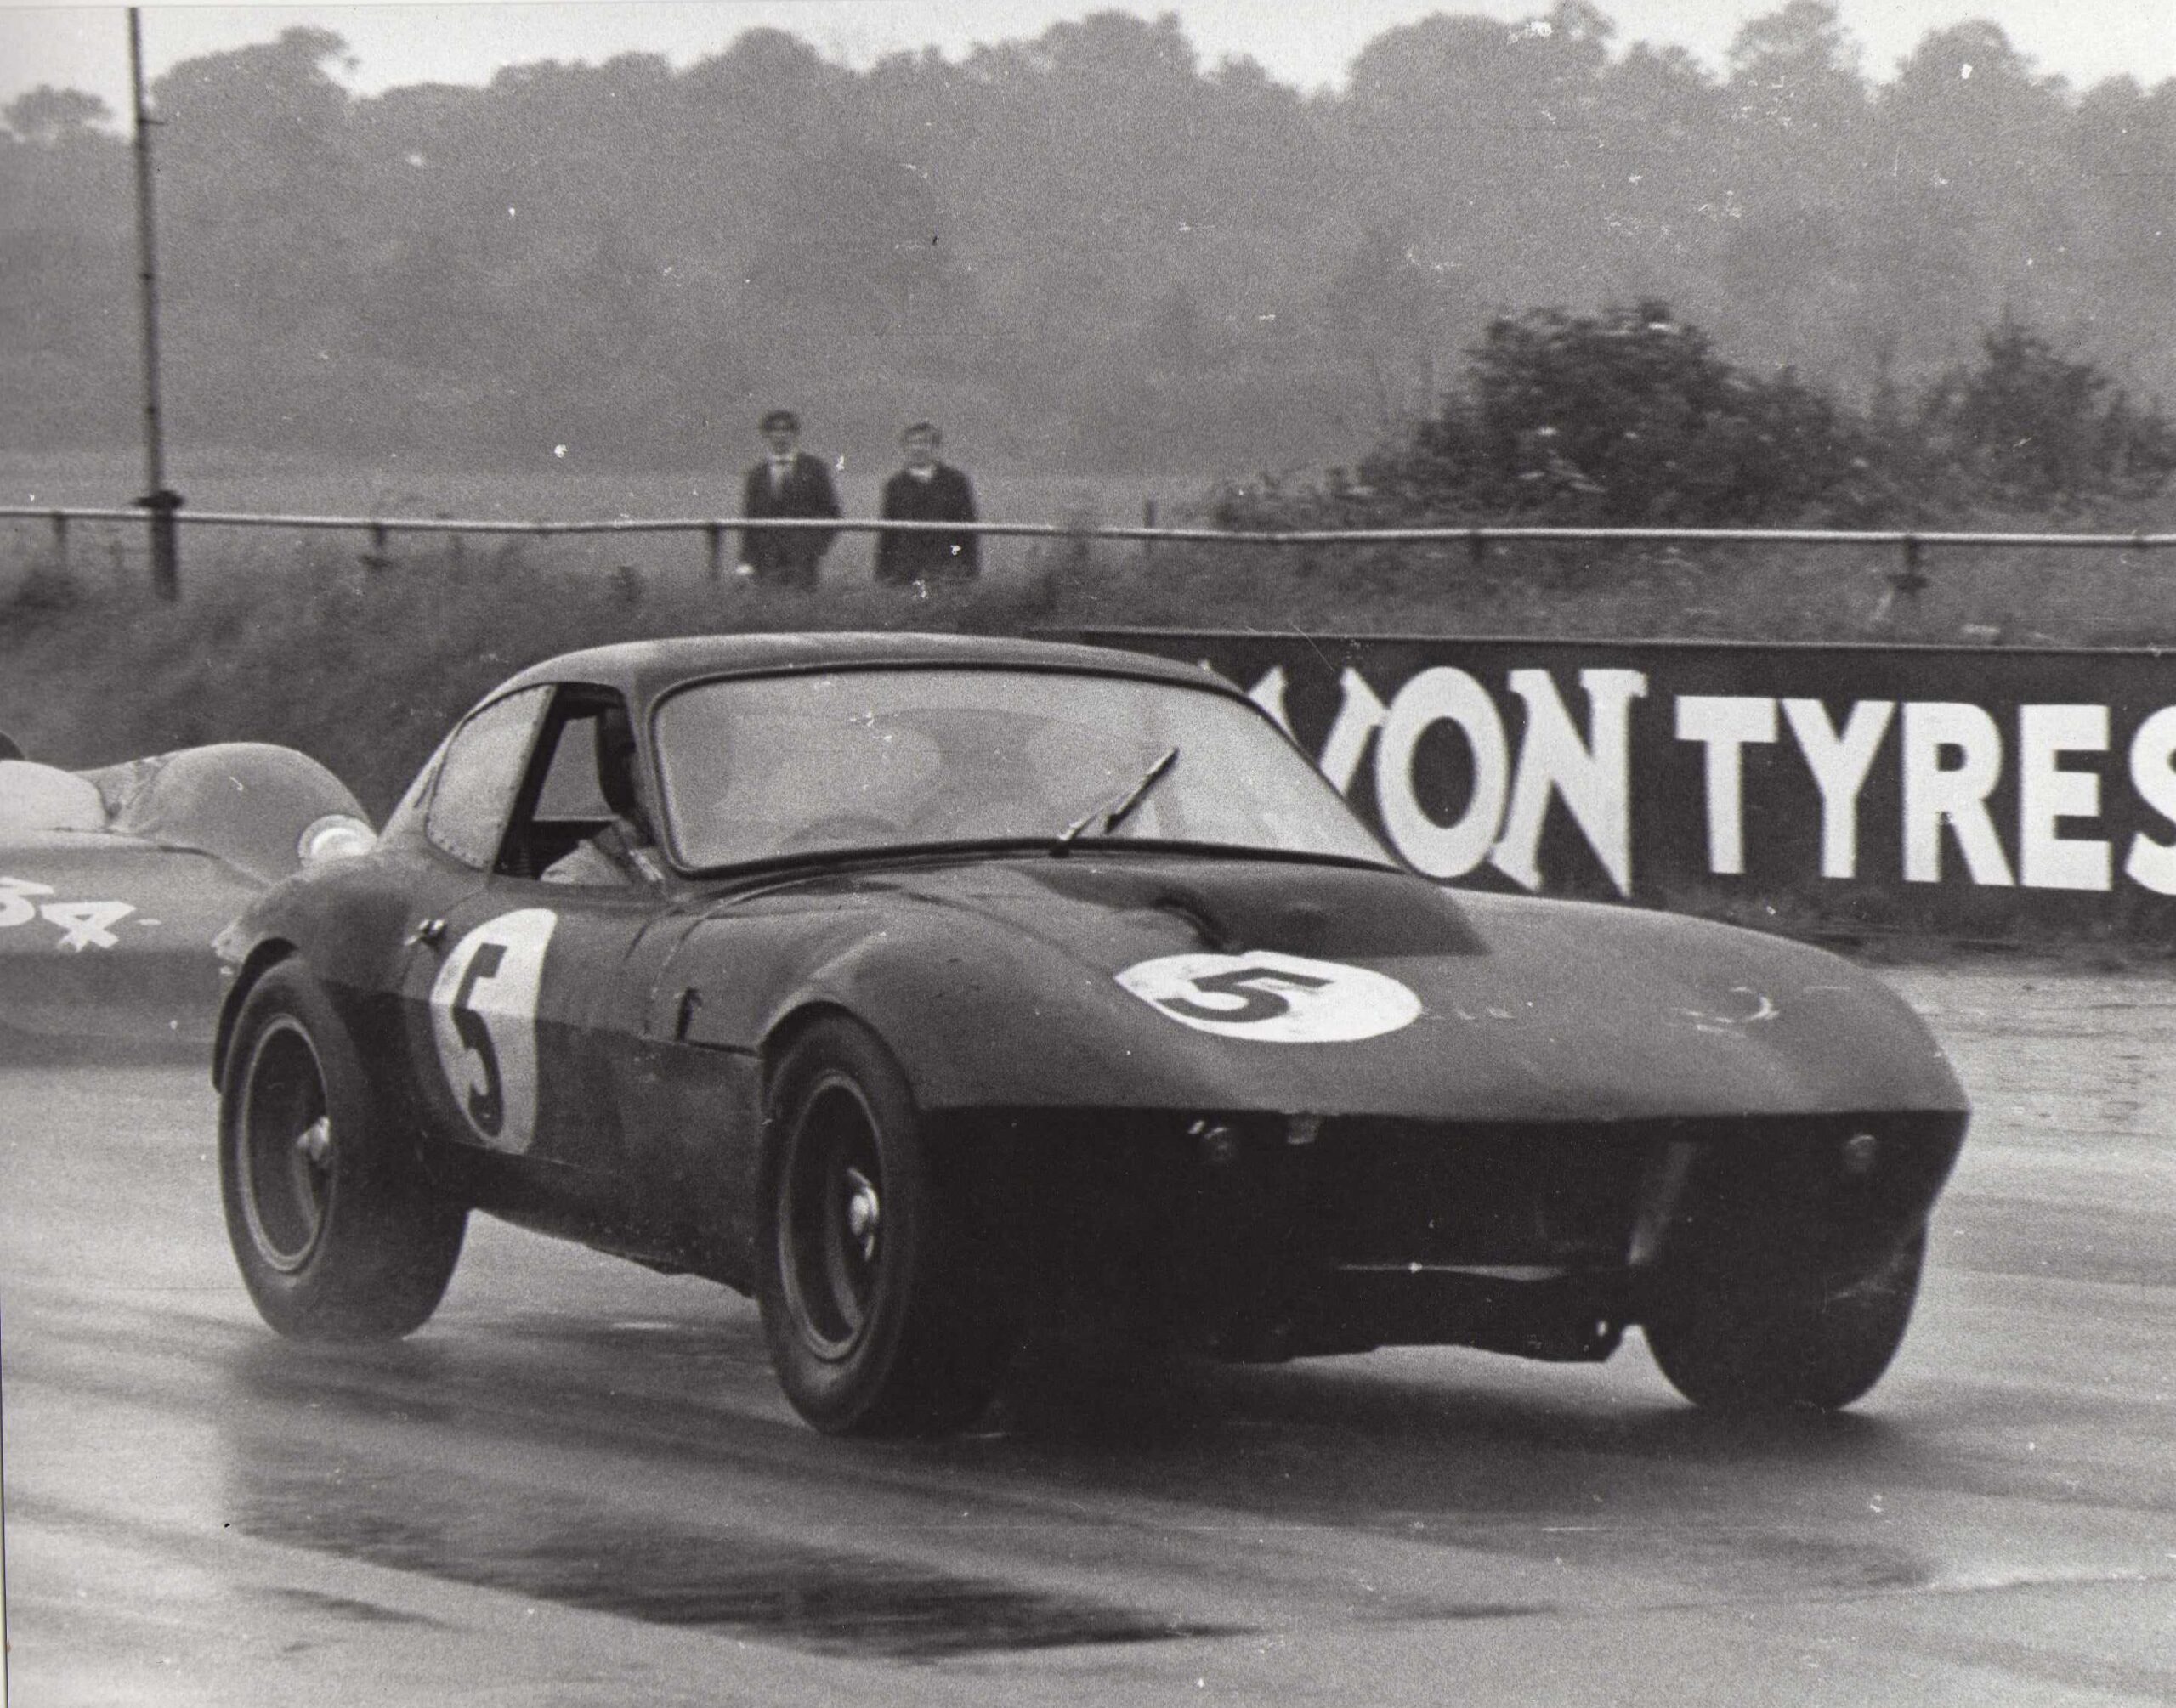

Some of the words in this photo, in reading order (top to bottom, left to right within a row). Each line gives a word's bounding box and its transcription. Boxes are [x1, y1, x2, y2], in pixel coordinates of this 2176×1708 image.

[1200, 659, 1648, 897] VON
[450, 942, 508, 1138] 5
[1153, 966, 1335, 1023] 5
